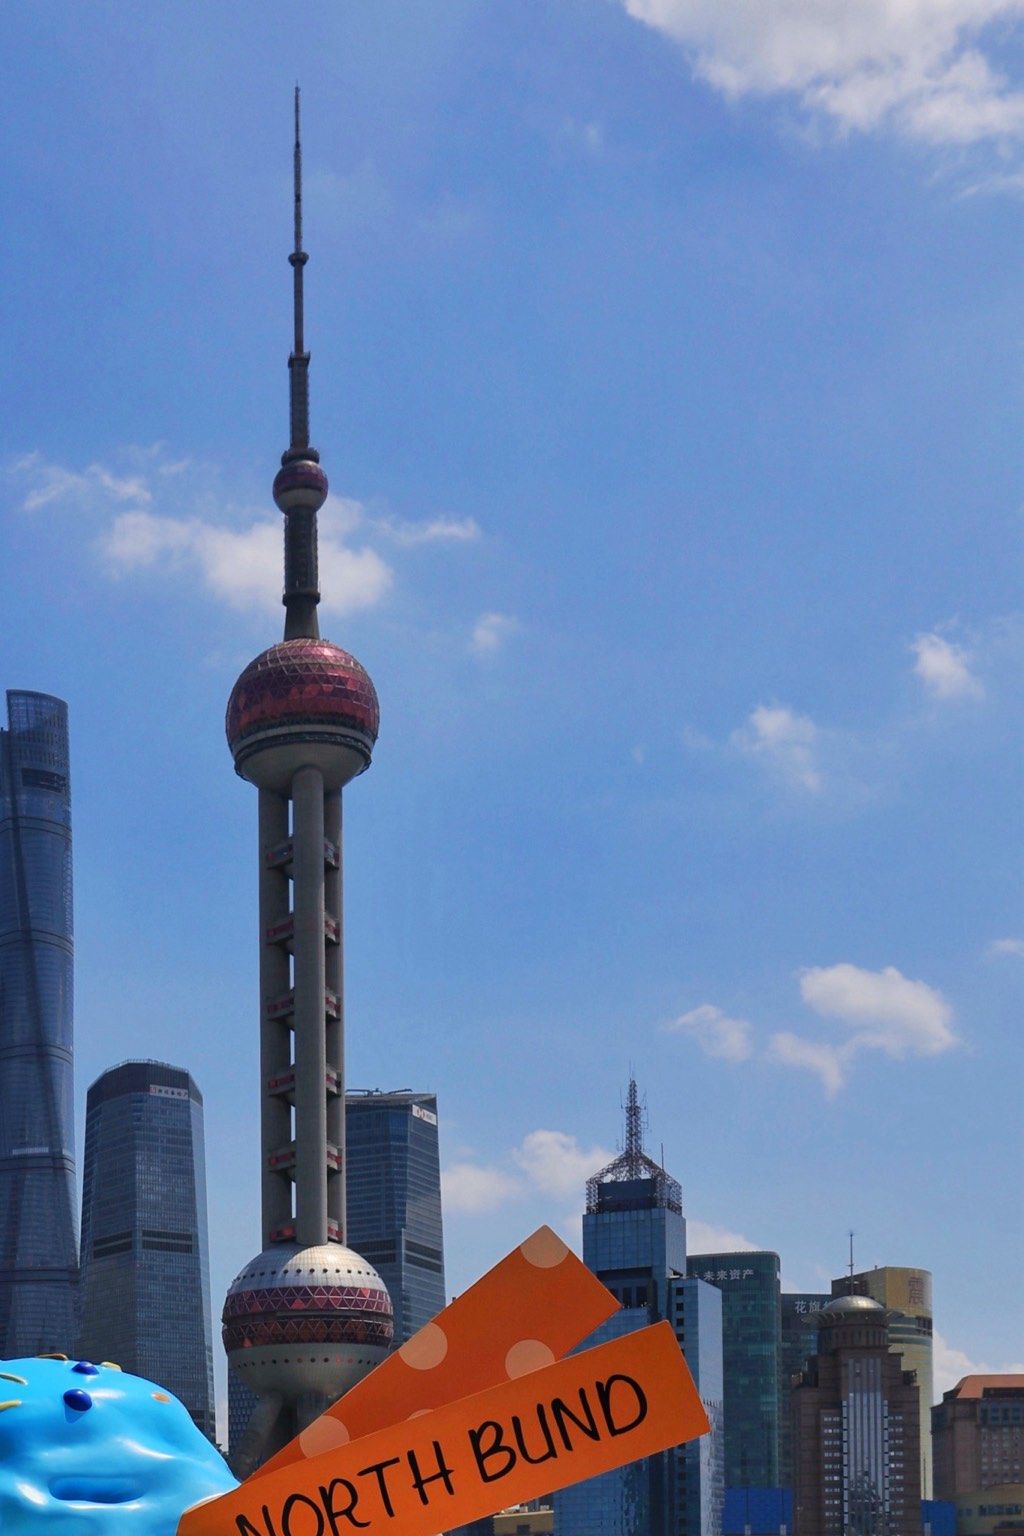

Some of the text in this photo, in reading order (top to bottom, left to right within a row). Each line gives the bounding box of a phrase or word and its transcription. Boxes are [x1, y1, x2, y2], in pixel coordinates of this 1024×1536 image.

[703, 1268, 755, 1281] 未来资产
[468, 1374, 648, 1484] BUND
